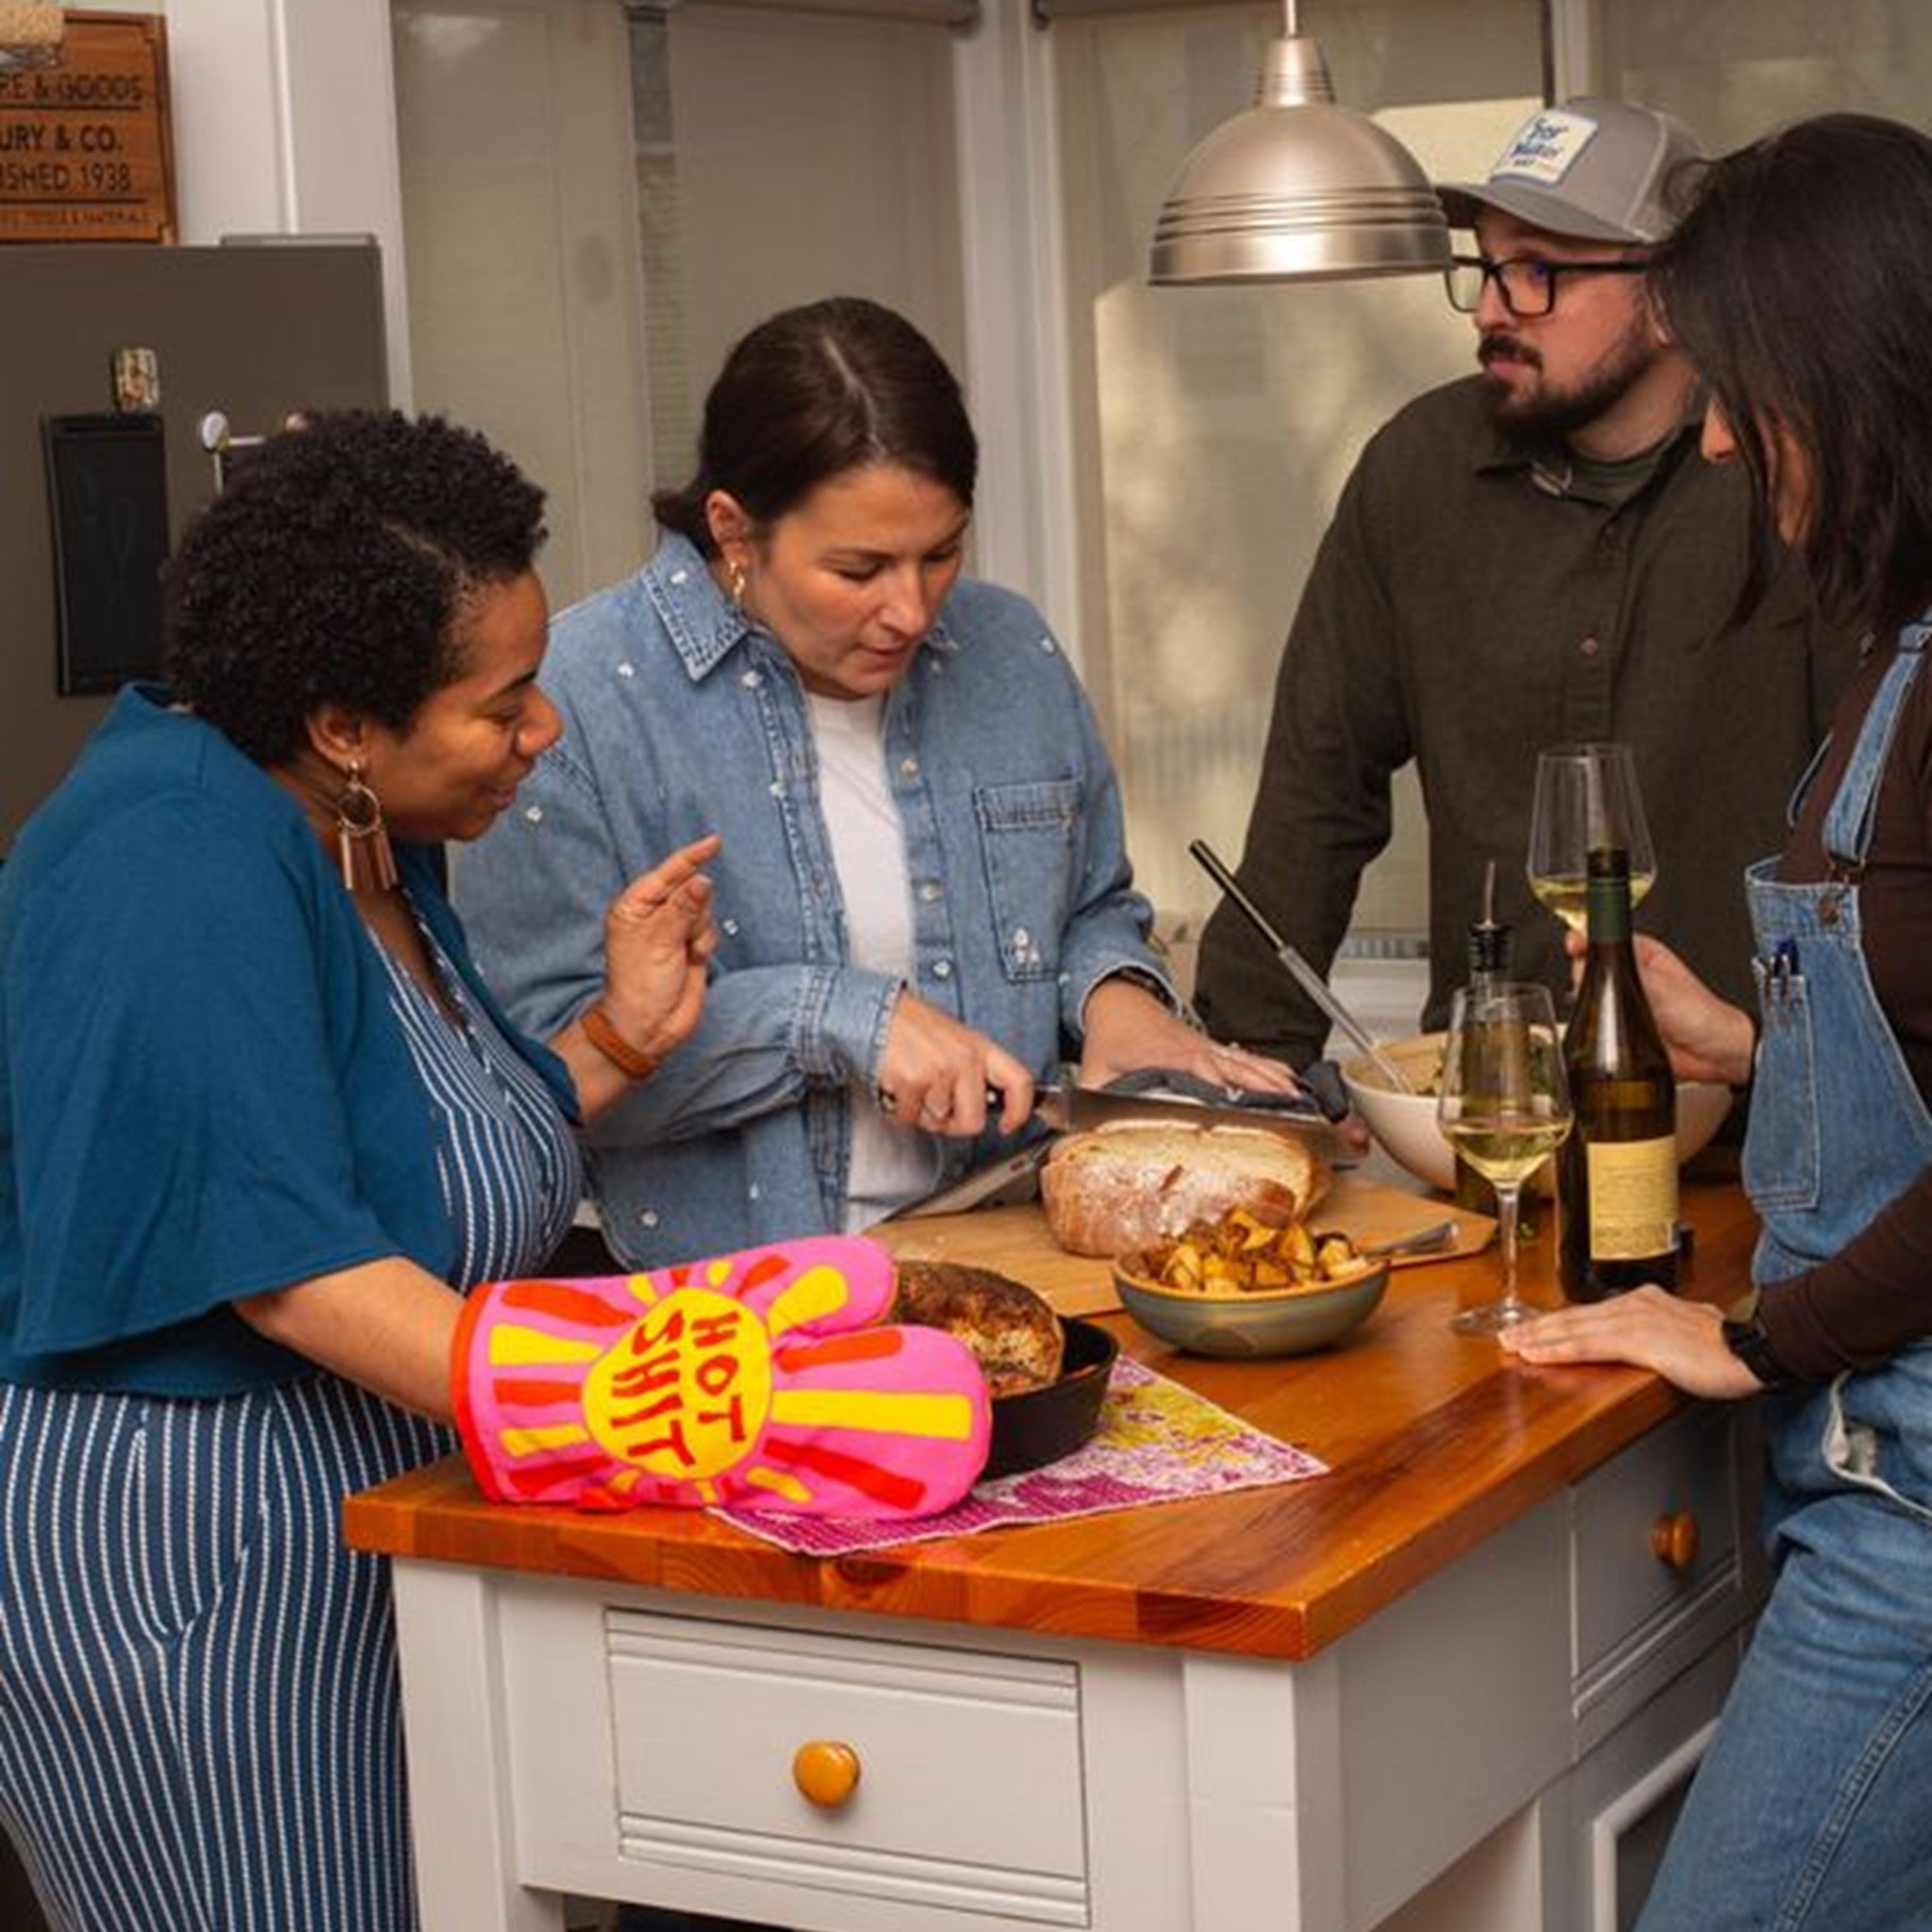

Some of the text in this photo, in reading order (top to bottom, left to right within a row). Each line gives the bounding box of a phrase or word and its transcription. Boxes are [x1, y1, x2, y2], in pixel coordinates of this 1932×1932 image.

[56, 73, 144, 102] GOODS
[54, 124, 72, 151] &
[79, 125, 124, 153] CO.
[81, 162, 130, 192] 1938
[610, 1309, 697, 1467] SHIT
[690, 1310, 746, 1443] HOT
